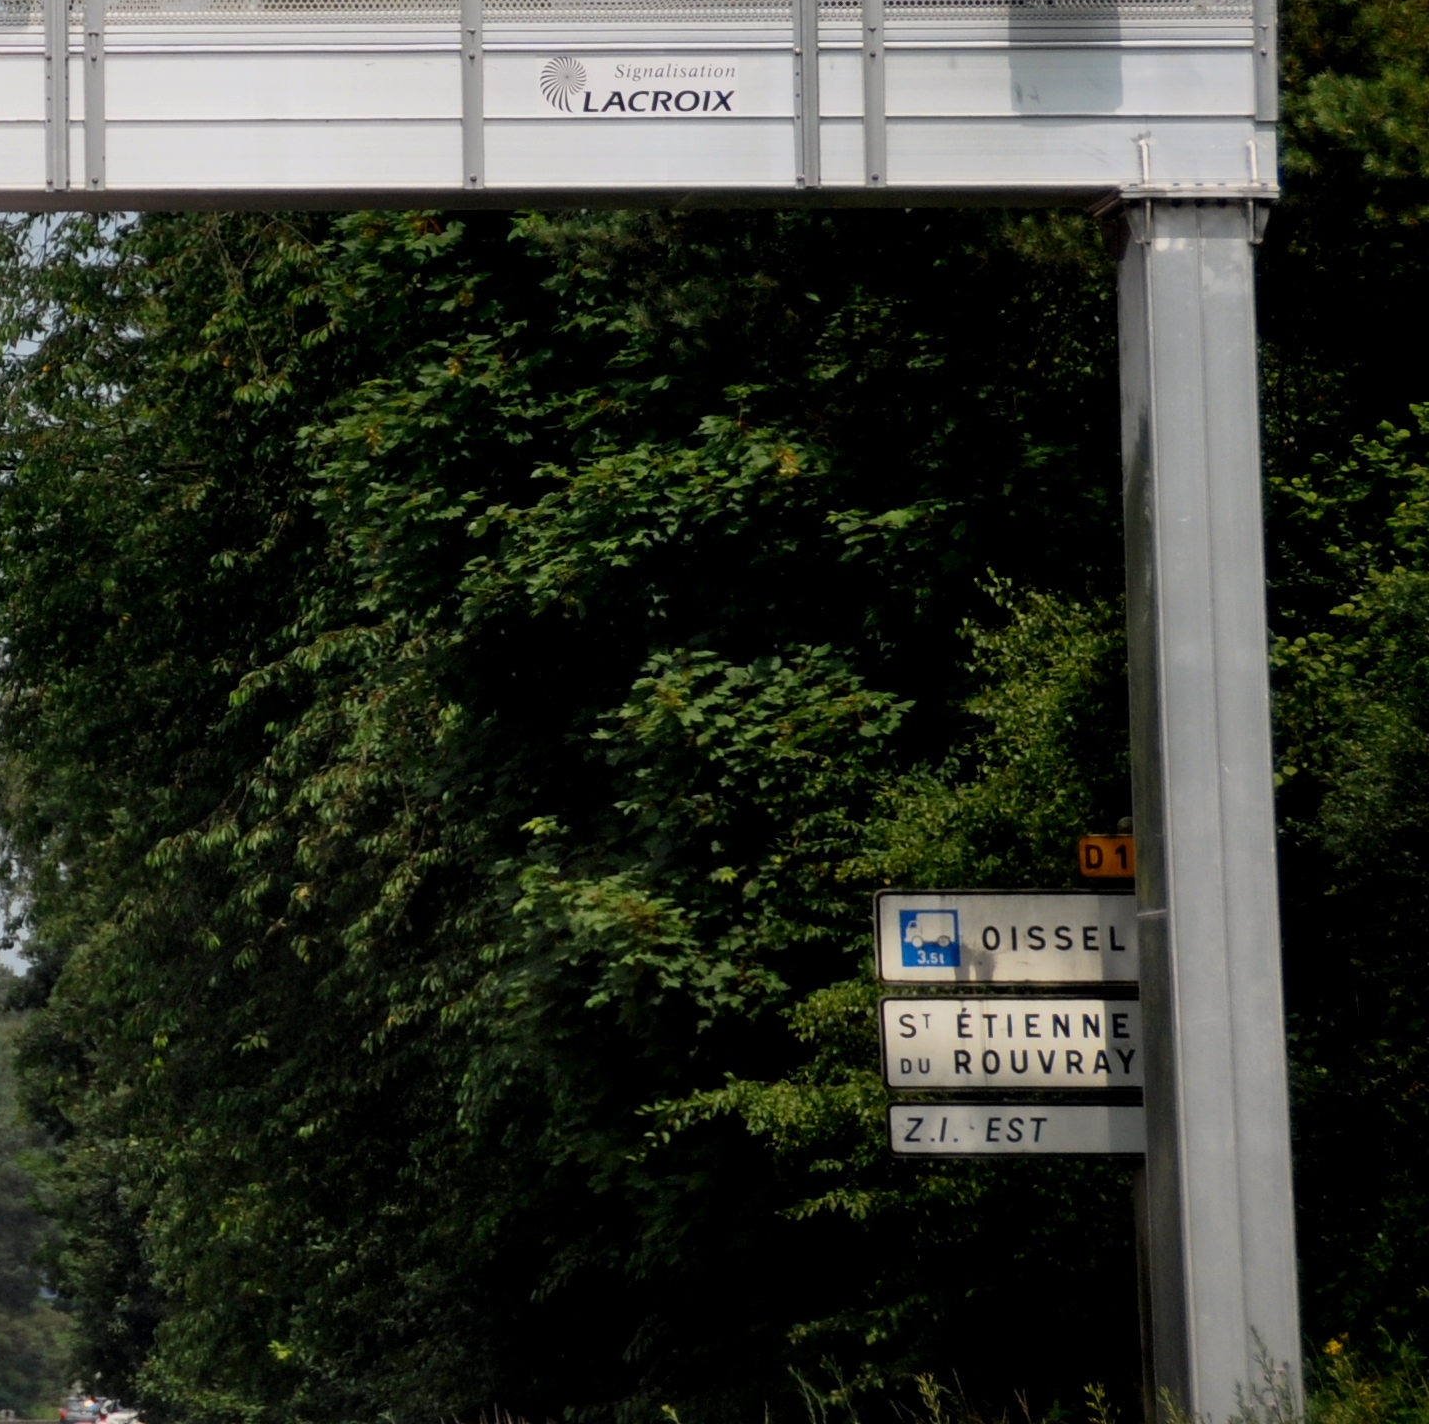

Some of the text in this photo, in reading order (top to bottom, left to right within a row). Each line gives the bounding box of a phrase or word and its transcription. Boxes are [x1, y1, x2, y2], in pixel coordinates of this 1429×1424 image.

[614, 62, 736, 83] Signalisation
[582, 89, 736, 113] LACROIX
[981, 925, 1126, 952] OISSEL
[956, 1007, 1130, 1039] ÉTIENNE
[900, 1049, 1136, 1075] DU ROUVRAY
[903, 1117, 1048, 1143] Z.I. EST
